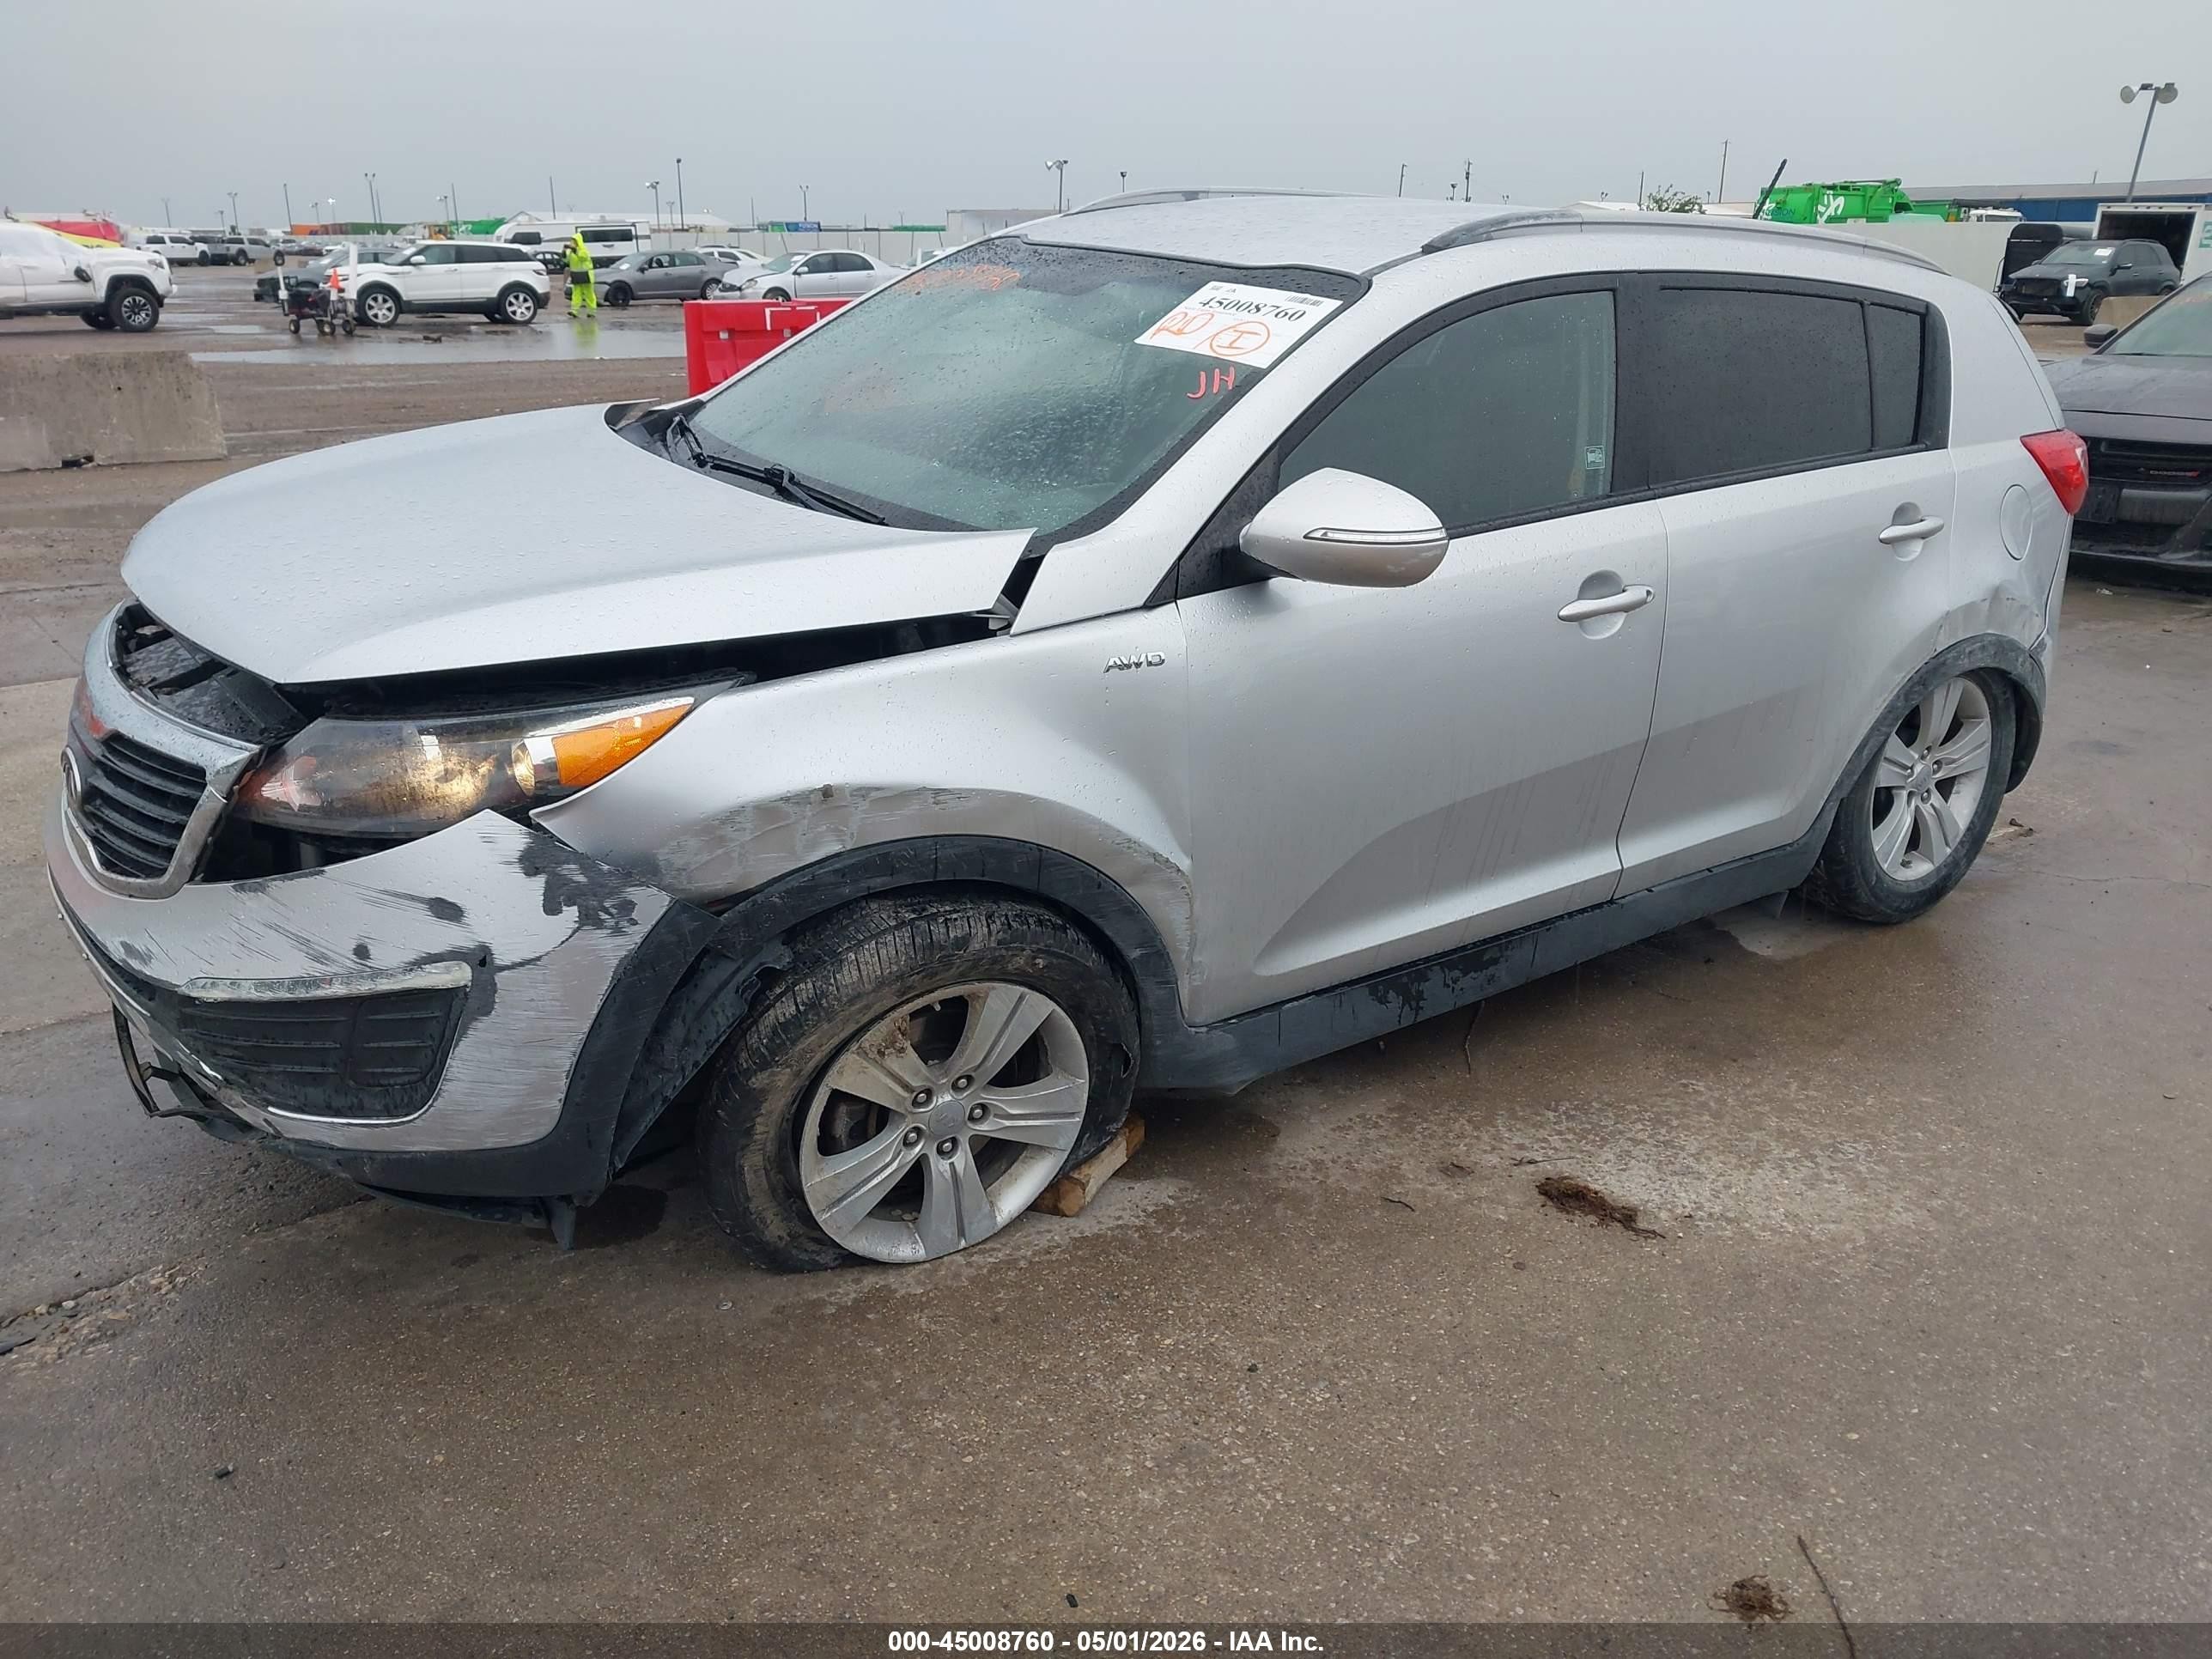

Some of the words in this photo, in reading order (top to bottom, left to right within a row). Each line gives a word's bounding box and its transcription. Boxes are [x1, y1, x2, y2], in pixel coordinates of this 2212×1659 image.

[1199, 295, 1306, 322] 45008760
[1187, 366, 1235, 398] JH
[1103, 651, 1165, 673] AWD
